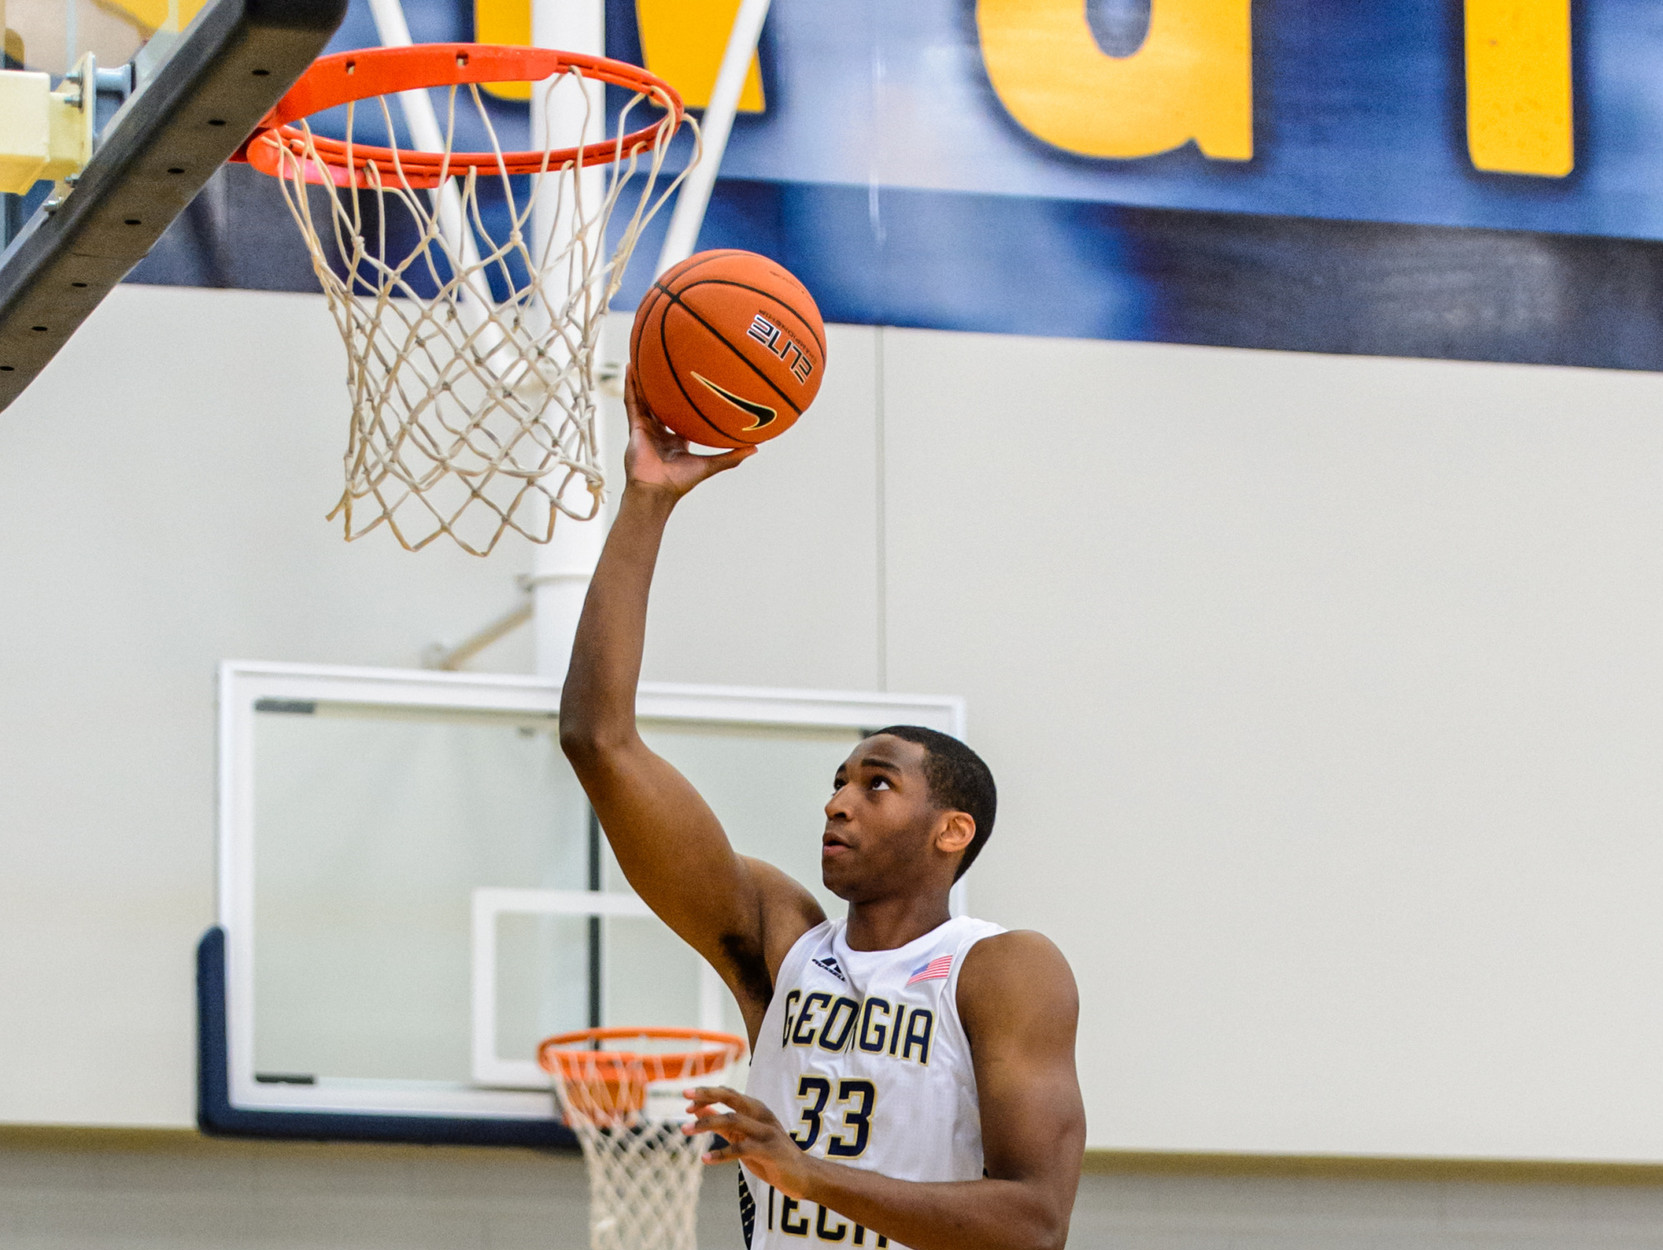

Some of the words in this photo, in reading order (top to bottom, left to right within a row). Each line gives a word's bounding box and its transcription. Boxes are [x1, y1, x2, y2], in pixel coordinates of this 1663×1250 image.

[746, 313, 814, 387] ELITE
[811, 958, 846, 982] RUSSELL
[782, 987, 936, 1067] GEOGIA
[788, 1073, 878, 1160] 33
[767, 1184, 889, 1250] EC
